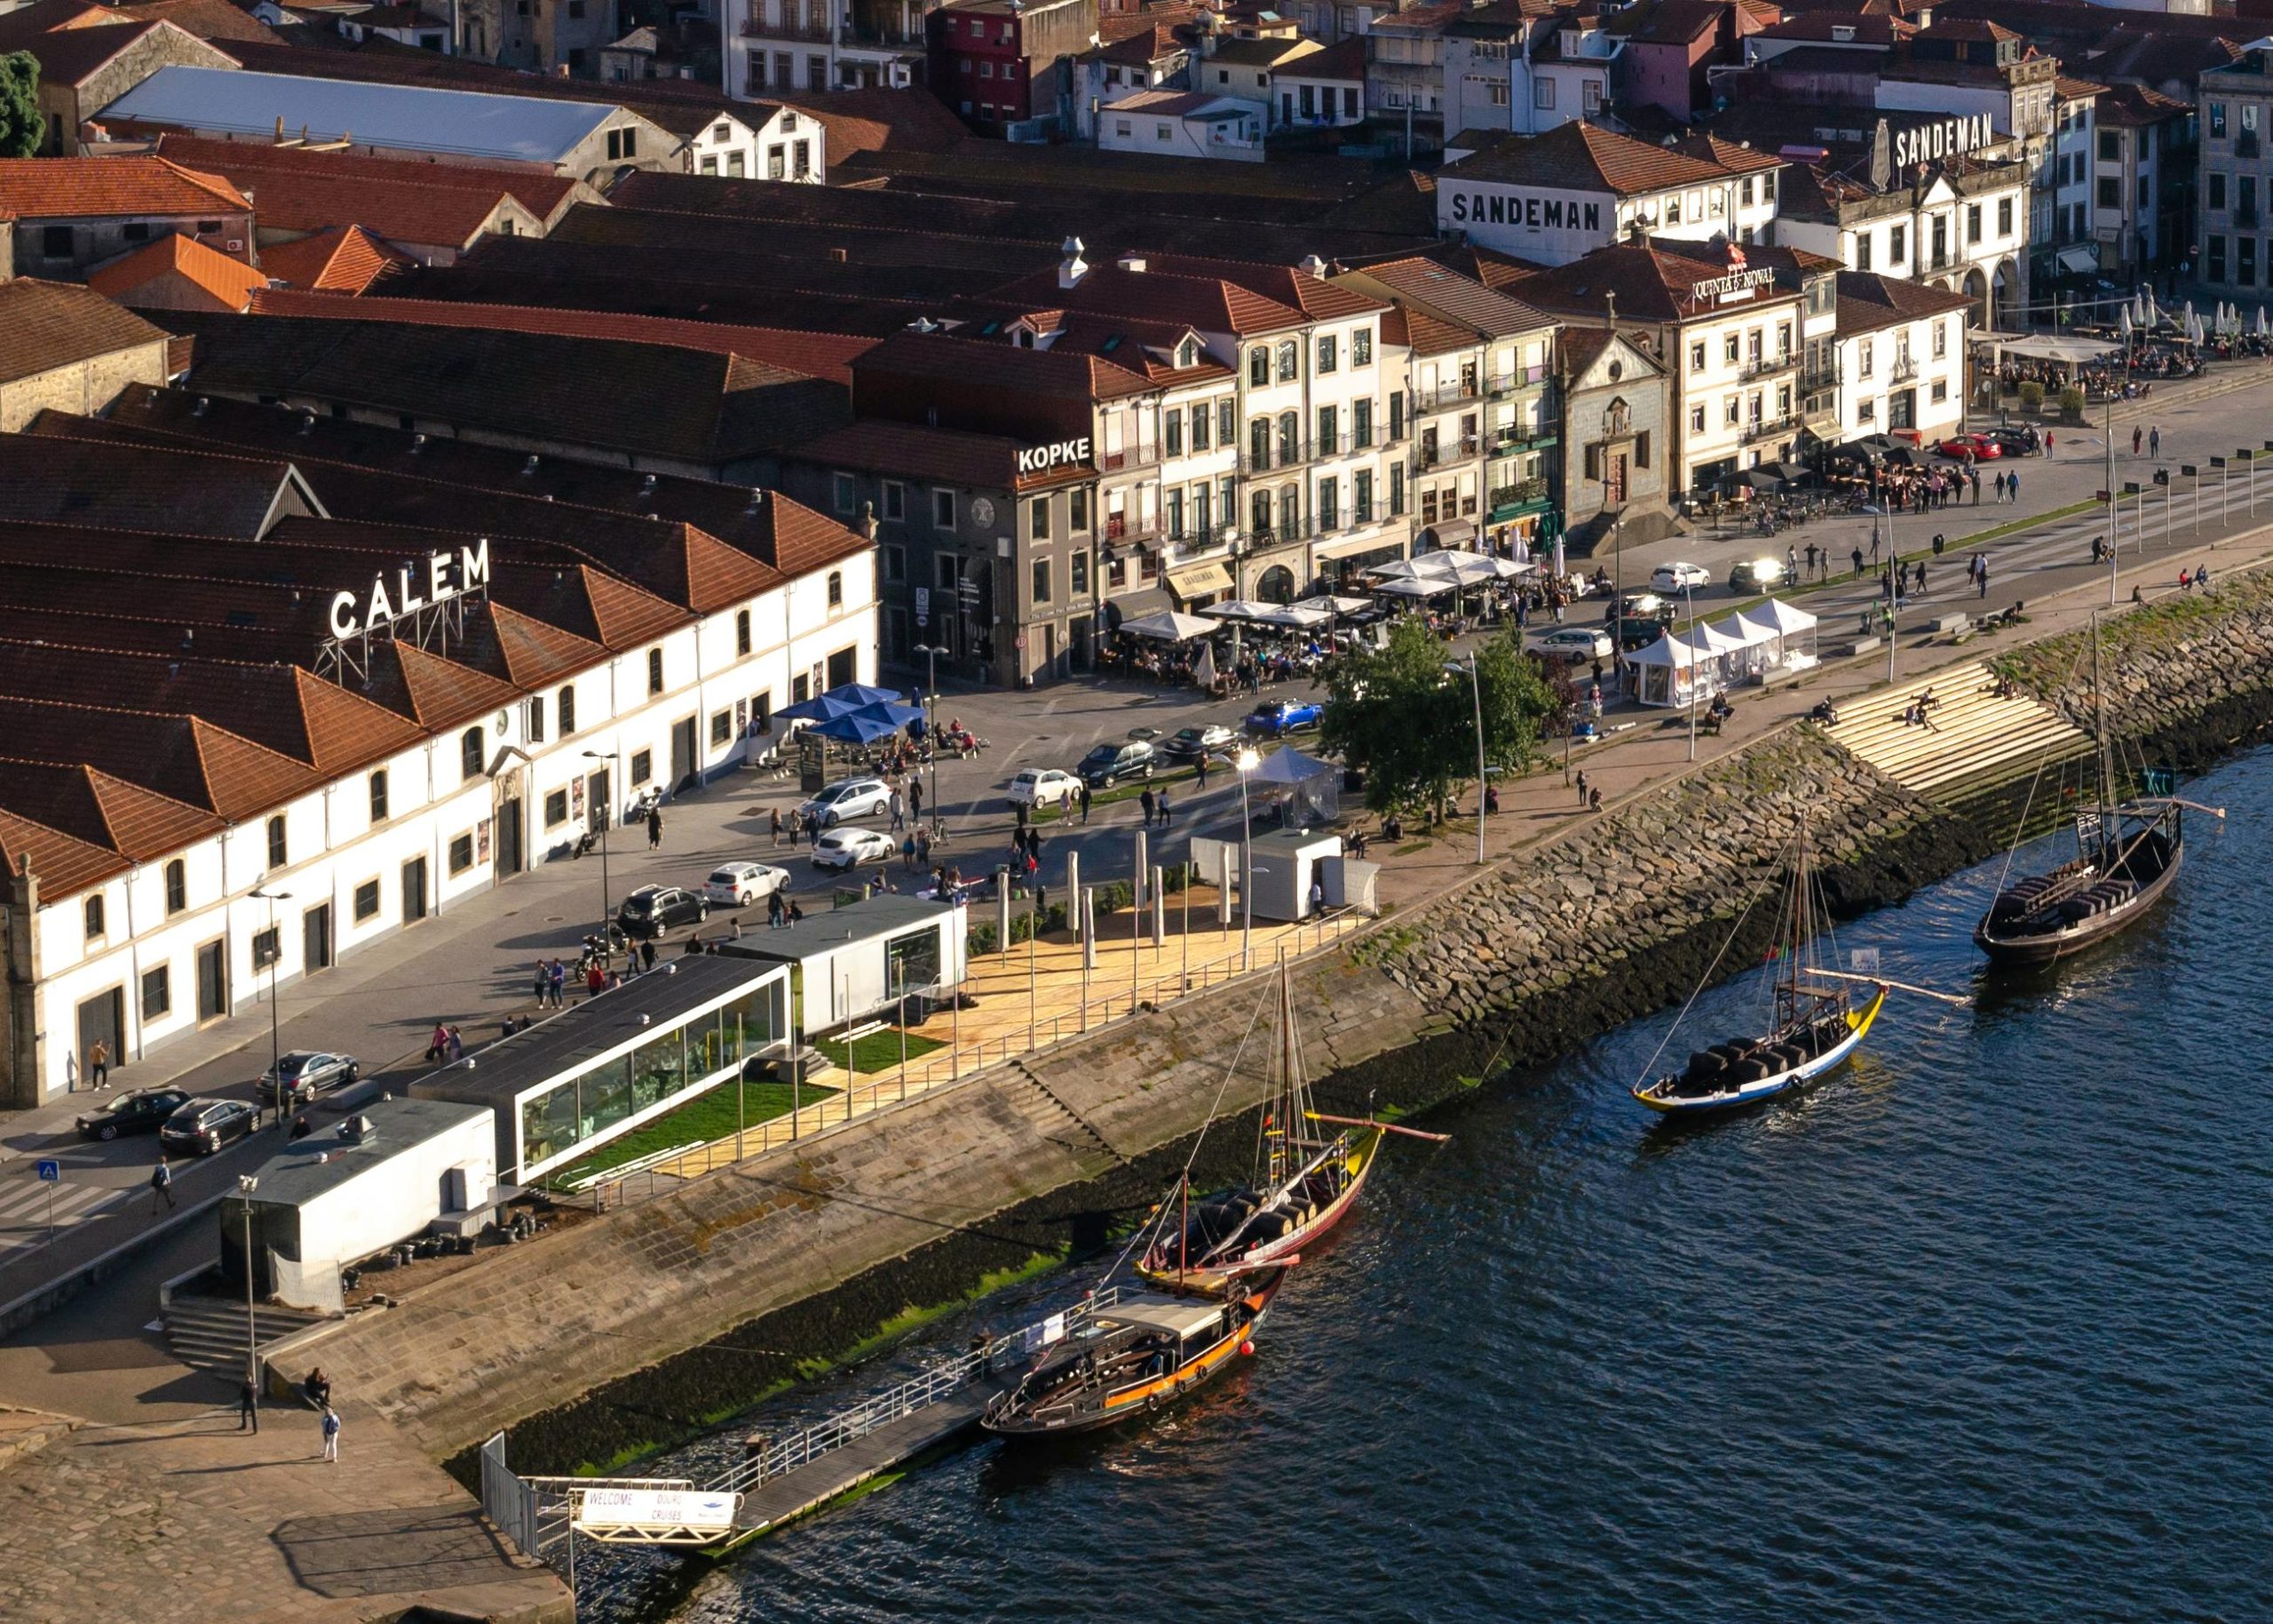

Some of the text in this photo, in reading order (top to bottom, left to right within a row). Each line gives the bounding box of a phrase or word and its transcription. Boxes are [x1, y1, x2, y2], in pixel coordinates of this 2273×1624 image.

[1897, 113, 1992, 168] SANDEMAN
[1453, 193, 1599, 231] SANDEMAN
[1695, 276, 1732, 300] QUINTA
[1744, 266, 1776, 287] NOVAL
[1018, 437, 1090, 472] KOPKE
[330, 538, 490, 639] CÁLEM
[590, 1493, 633, 1506] WELCOME
[652, 1509, 682, 1521] CRUISES
